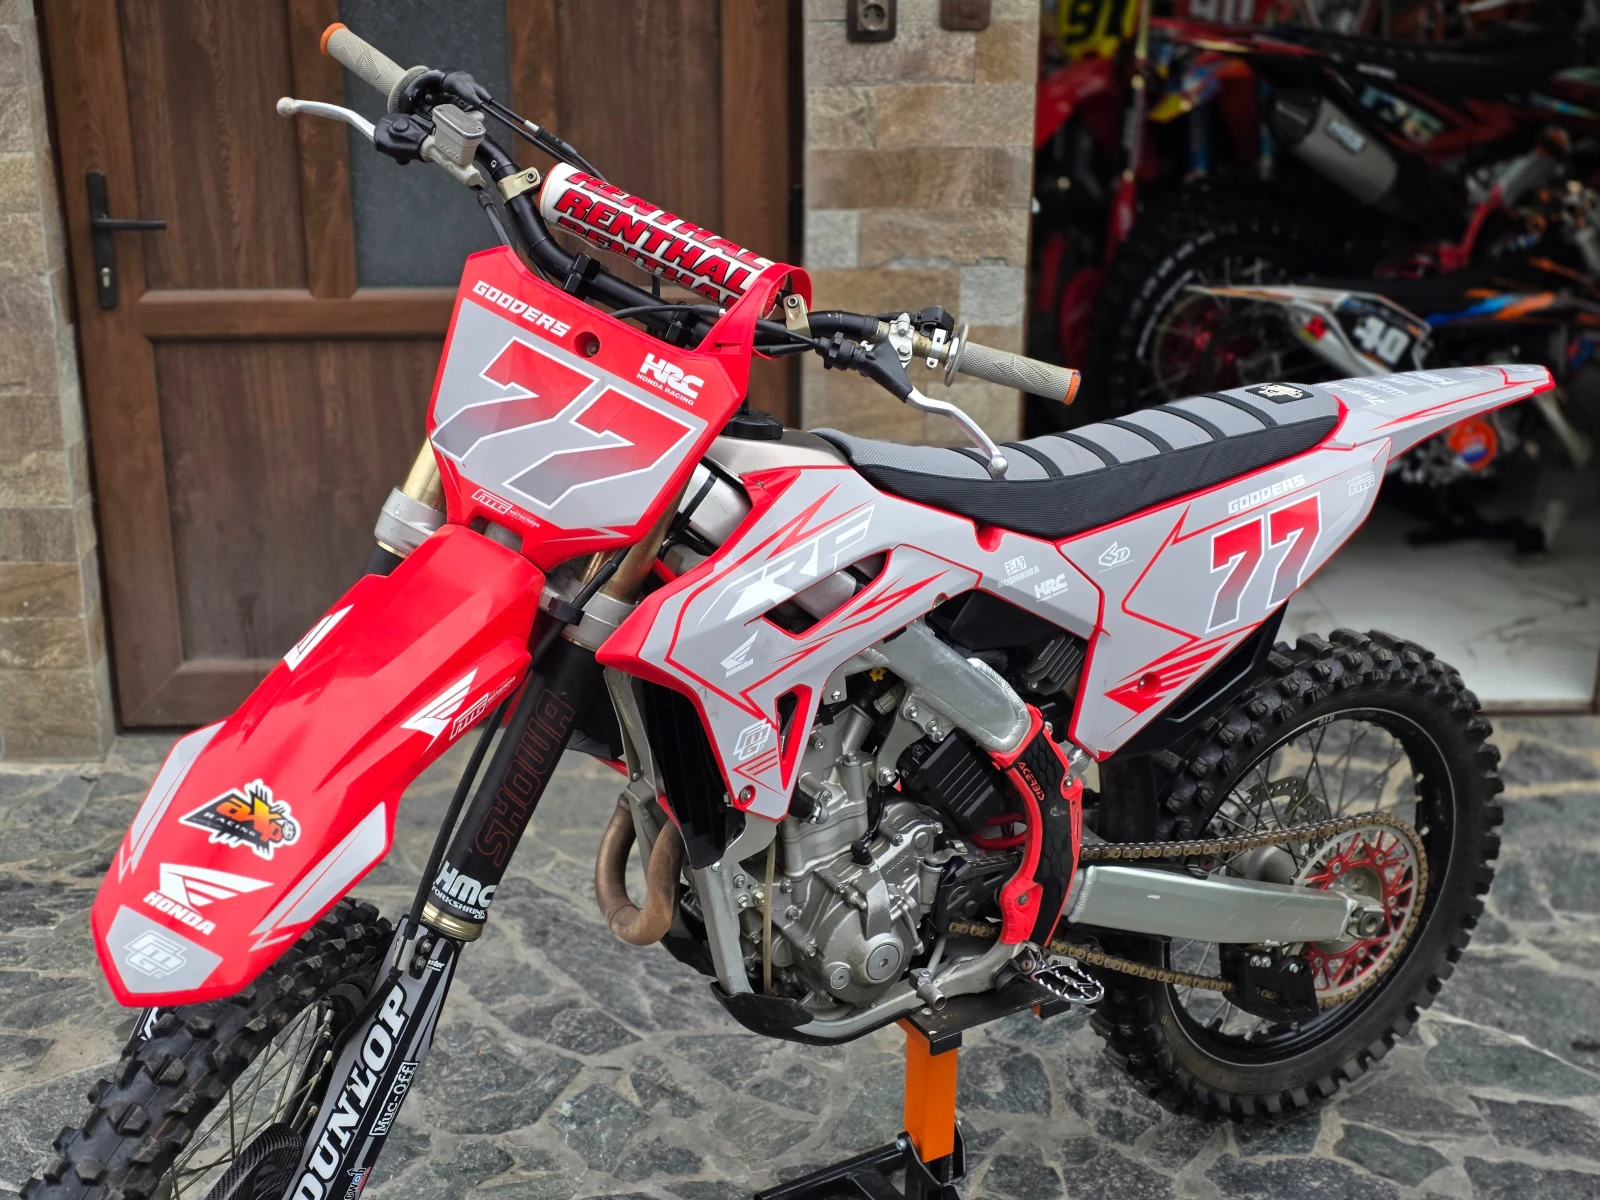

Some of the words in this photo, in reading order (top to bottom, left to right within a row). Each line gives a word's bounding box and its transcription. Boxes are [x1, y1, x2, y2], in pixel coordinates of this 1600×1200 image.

[554, 188, 752, 296] RENTHAL
[472, 280, 571, 338] GOODERS
[636, 372, 663, 391] HONDA
[664, 387, 695, 406] RACING
[639, 352, 705, 400] HRC
[431, 335, 697, 511] 77
[1228, 474, 1306, 514] GOODERS
[1033, 572, 1068, 599] HRC
[1204, 491, 1321, 634] 77
[724, 657, 754, 679] HONDA
[474, 688, 574, 868] SHOWA
[1017, 761, 1046, 801] ACERBIS
[202, 811, 257, 838] RACING
[434, 860, 499, 909] HMC
[143, 889, 217, 936] HONDA
[290, 984, 406, 1200] DUNLOP
[374, 1062, 418, 1135] Muc-Off
